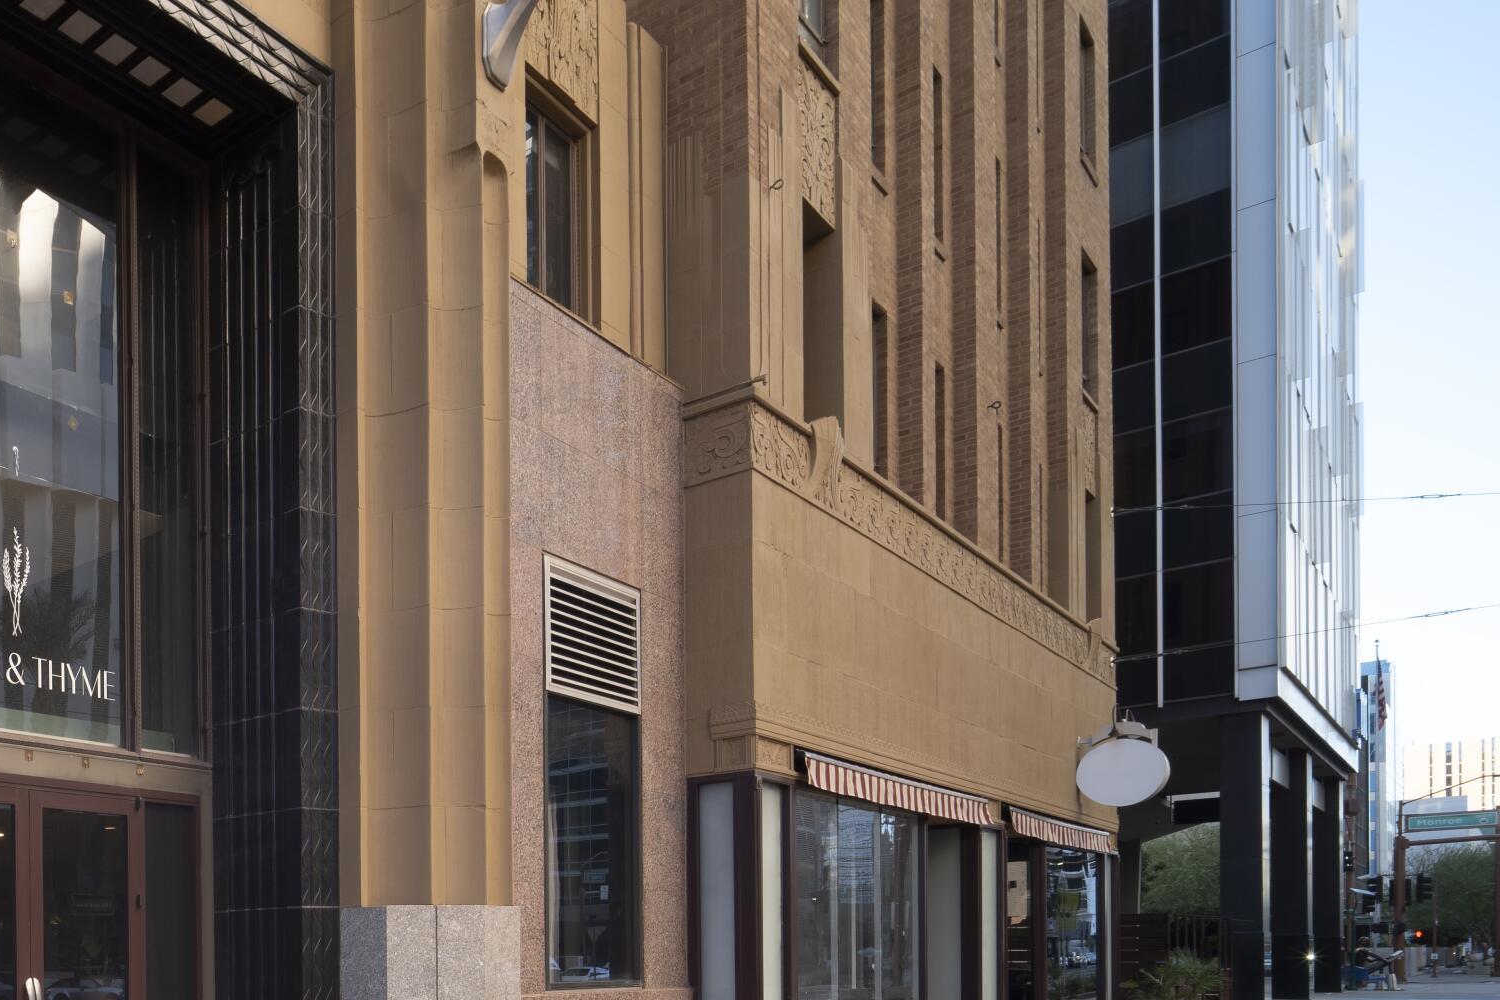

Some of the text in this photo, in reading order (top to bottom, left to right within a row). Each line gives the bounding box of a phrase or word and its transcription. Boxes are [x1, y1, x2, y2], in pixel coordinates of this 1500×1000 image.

[6, 652, 26, 686] &
[31, 656, 116, 701] THYME
[1416, 817, 1463, 827] Monroe
